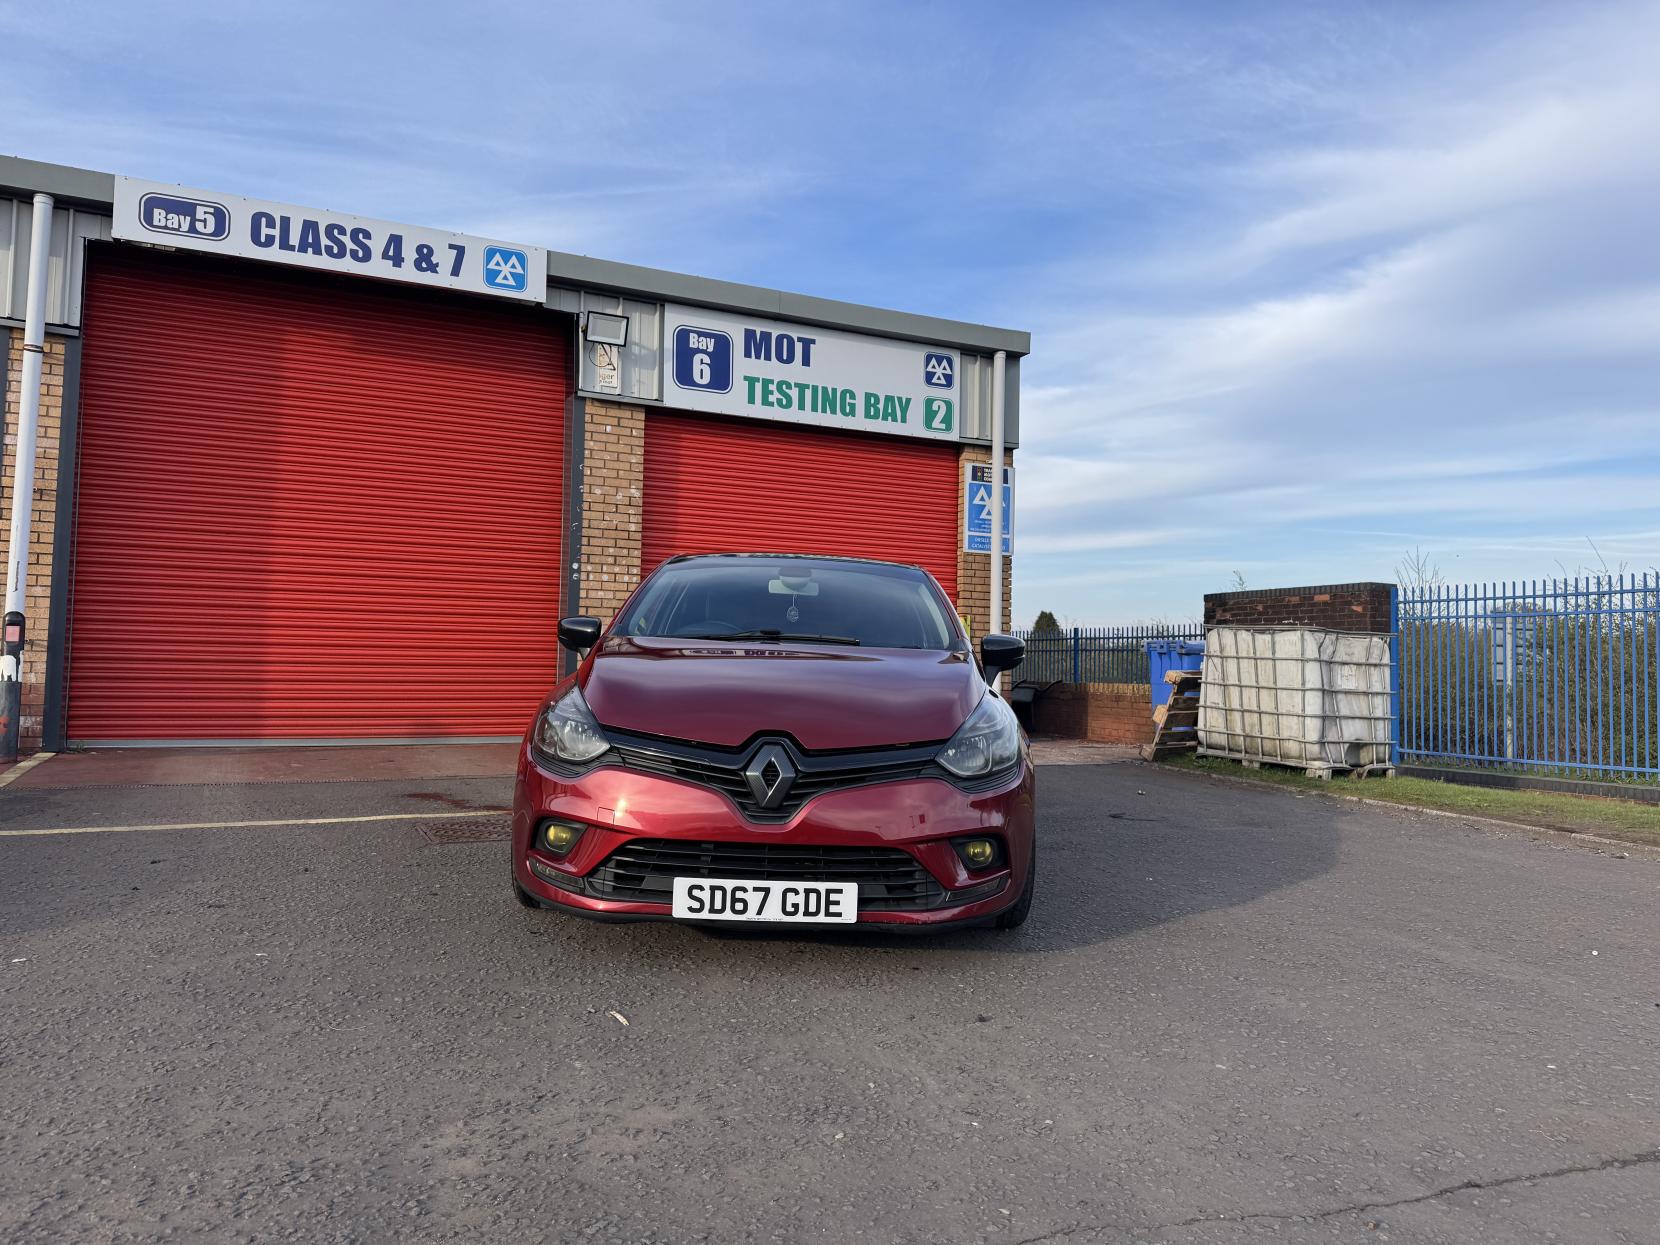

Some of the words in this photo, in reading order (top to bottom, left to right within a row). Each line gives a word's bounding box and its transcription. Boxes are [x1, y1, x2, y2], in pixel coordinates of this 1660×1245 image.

[153, 208, 190, 231] Bay
[195, 206, 216, 234] 5
[250, 211, 372, 263] CLASS
[381, 234, 404, 268] 4
[413, 244, 440, 274] &
[447, 243, 466, 277] 7
[689, 332, 715, 353] Bay
[743, 328, 816, 367] MOT
[692, 353, 711, 385] 6
[743, 375, 857, 418] TESTING
[863, 391, 912, 424] BAY
[931, 400, 946, 430] 2
[687, 884, 771, 916] SD67
[781, 887, 843, 918] GDE
